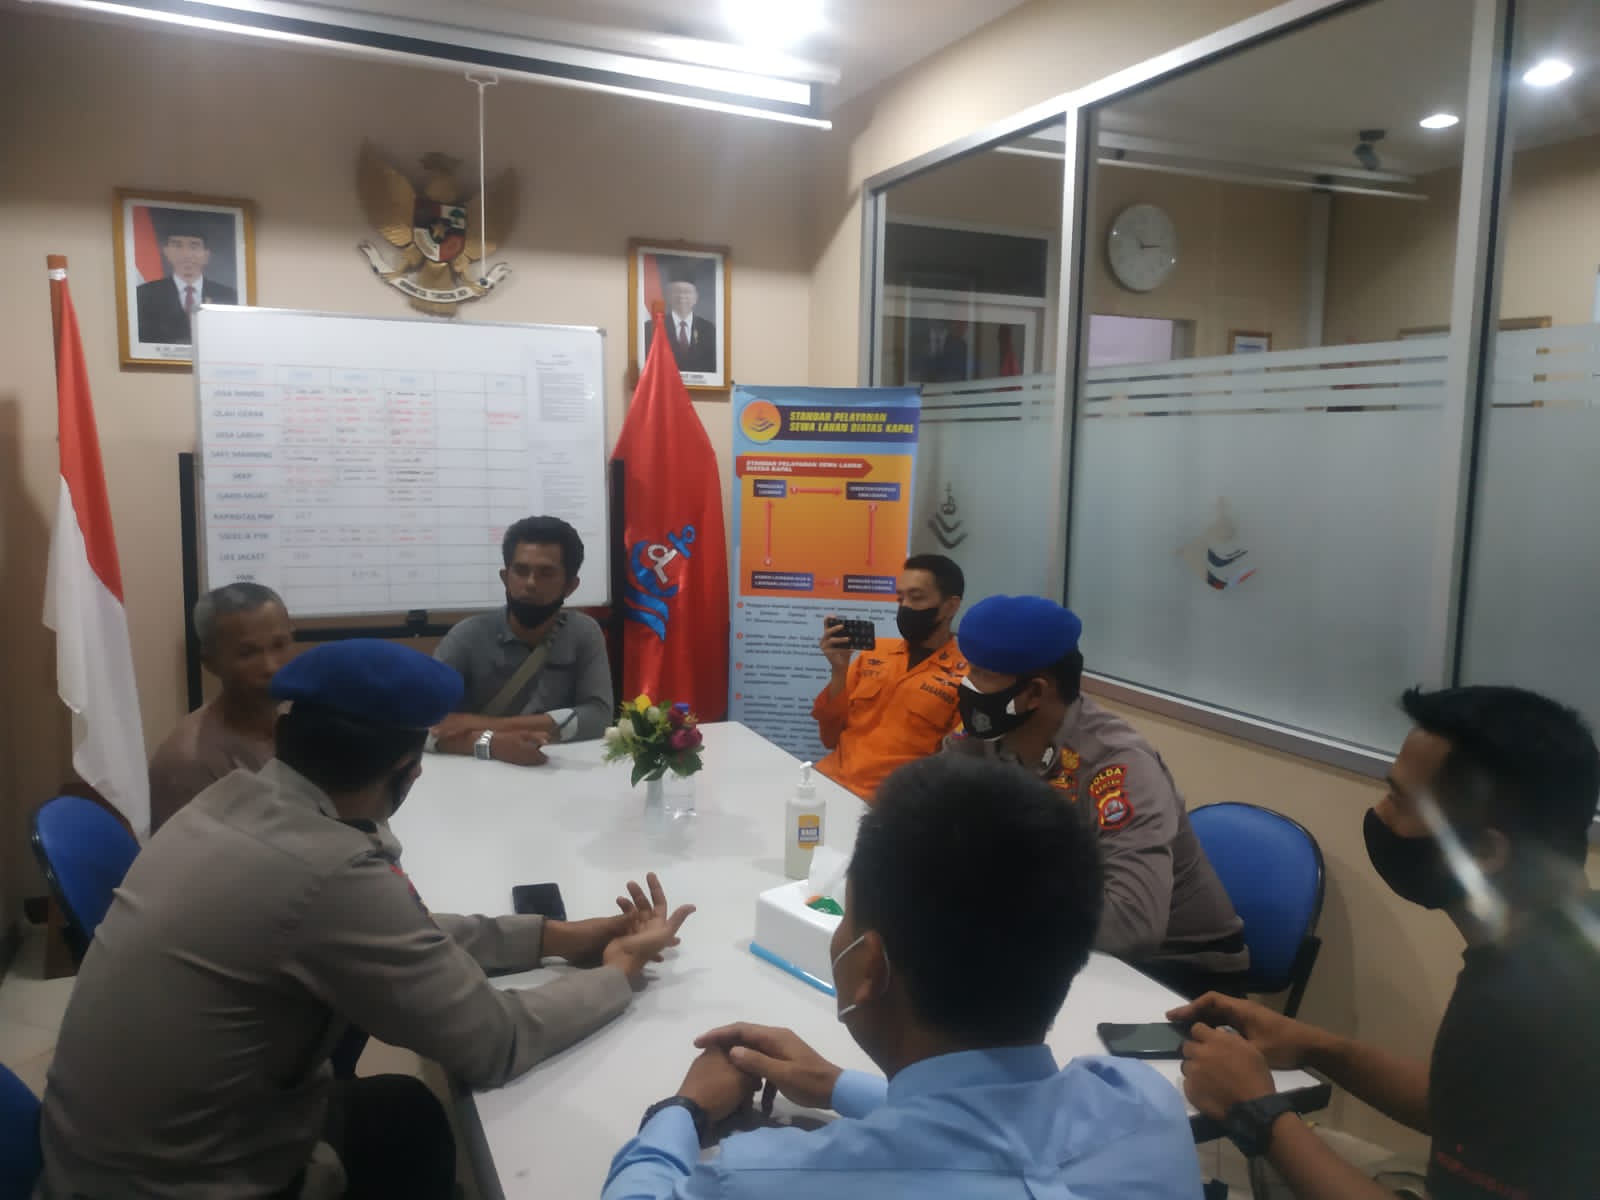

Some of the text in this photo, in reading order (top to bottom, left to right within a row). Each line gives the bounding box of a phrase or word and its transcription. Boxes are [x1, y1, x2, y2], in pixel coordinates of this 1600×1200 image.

[789, 411, 888, 422] STANDAR PELAYANAN
[789, 422, 914, 434] SEWA LAHAN DIATAS KAPAL
[1089, 767, 1122, 792] POLDA
